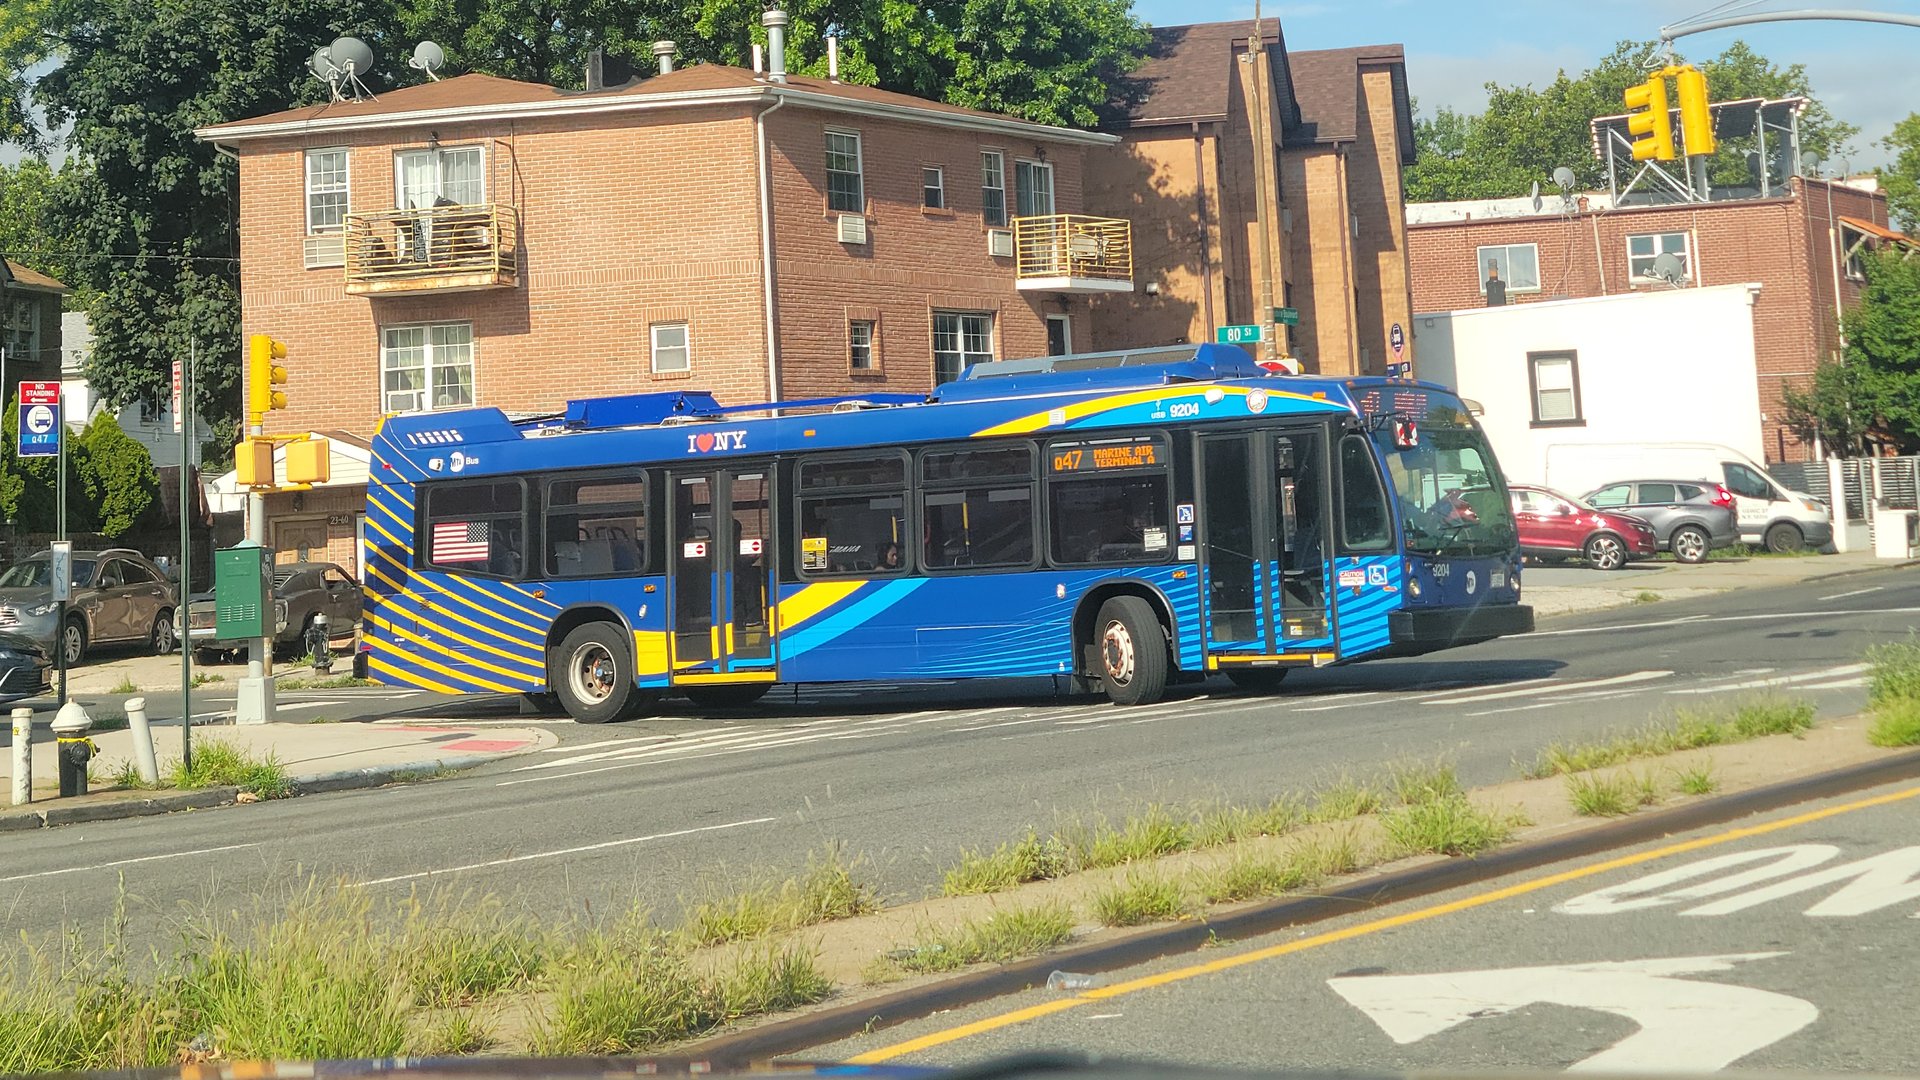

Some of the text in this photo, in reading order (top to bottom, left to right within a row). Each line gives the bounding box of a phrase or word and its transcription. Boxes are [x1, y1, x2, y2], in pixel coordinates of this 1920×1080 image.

[1227, 327, 1252, 341] 80 St
[1150, 411, 1166, 419] USB
[1169, 402, 1199, 418] 9204
[687, 434, 697, 453] I
[1093, 445, 1154, 459] MARINE AIR
[465, 457, 480, 465] Bus
[1054, 450, 1083, 471] Q47
[1094, 455, 1155, 468] TERMINAL A
[329, 515, 349, 525] 23-60
[1339, 570, 1364, 578] CAUTION
[1432, 563, 1450, 577] 9204
